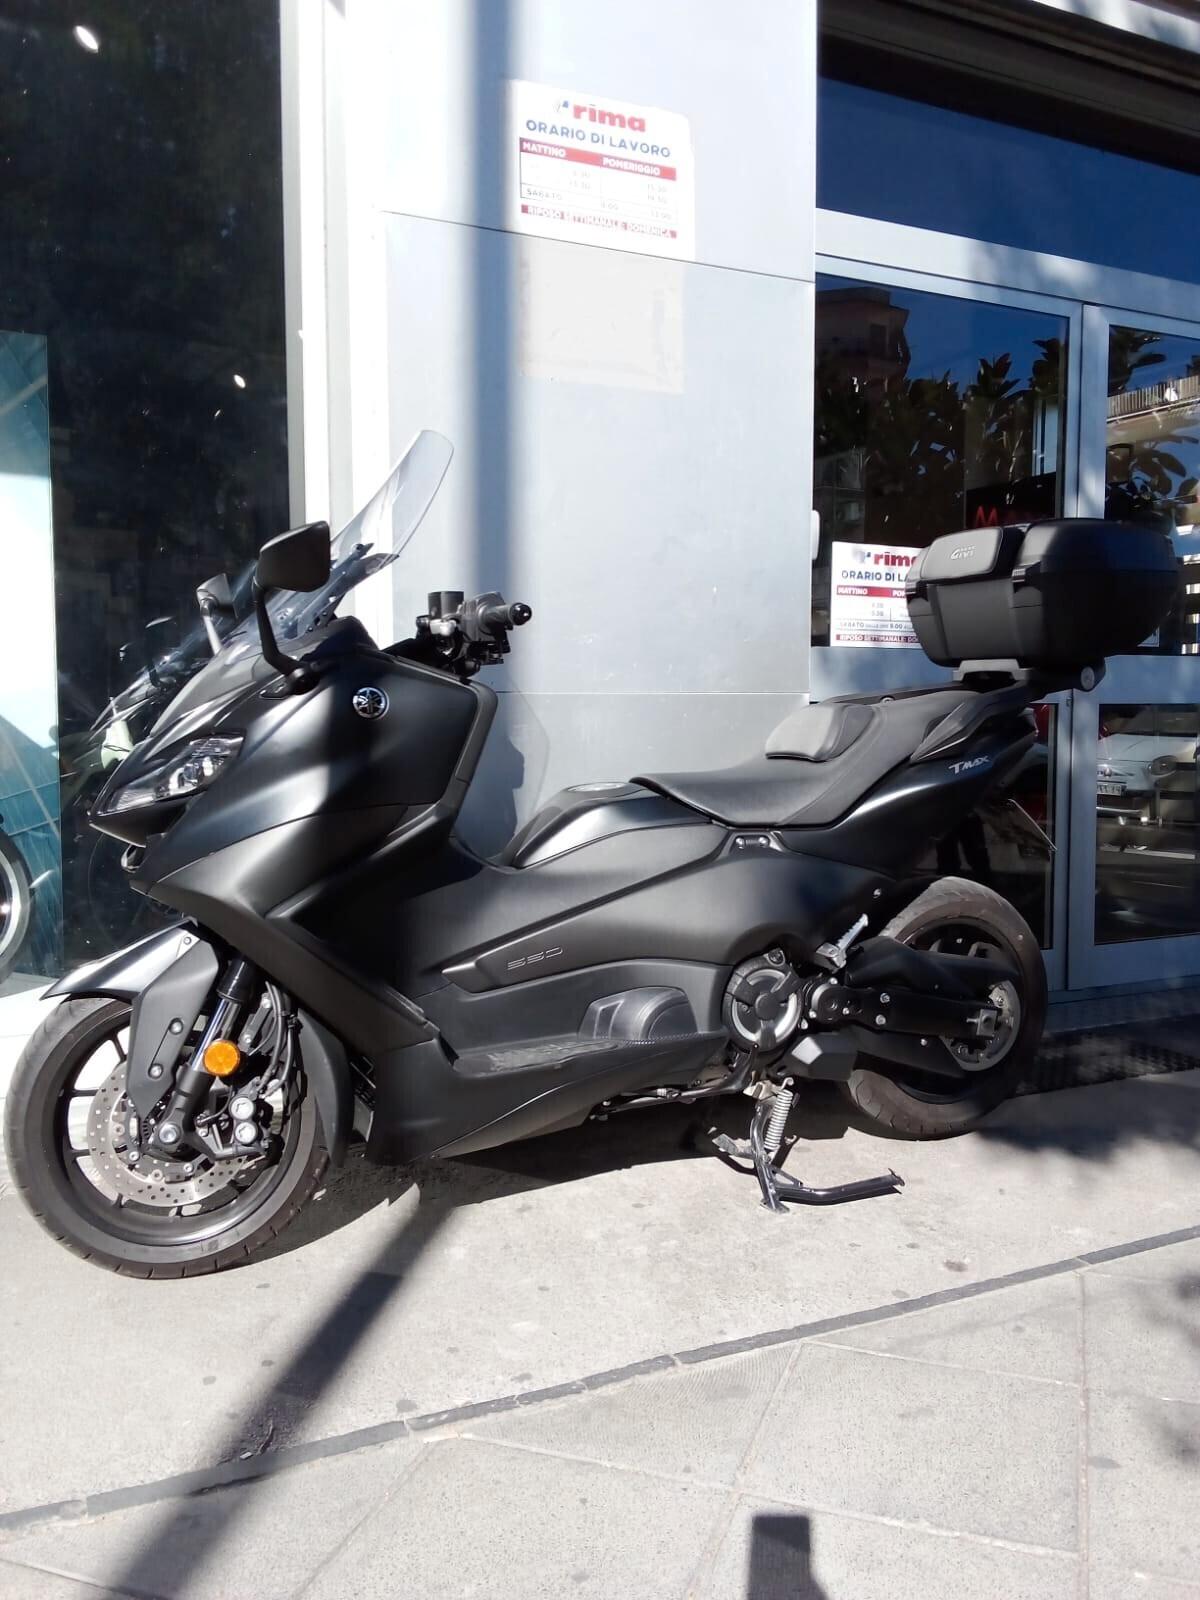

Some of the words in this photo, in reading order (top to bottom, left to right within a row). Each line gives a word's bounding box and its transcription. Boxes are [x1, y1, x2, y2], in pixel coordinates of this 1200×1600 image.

[526, 119, 586, 142] ORARIO
[590, 132, 605, 145] DI
[609, 135, 671, 158] LAVORO
[522, 141, 567, 158] MATTINO
[602, 157, 661, 176] POMERIGGIO
[841, 570, 882, 581] ORARIO
[885, 572, 895, 581] DI
[838, 587, 868, 596] MATTINO
[948, 755, 990, 775] TMAX
